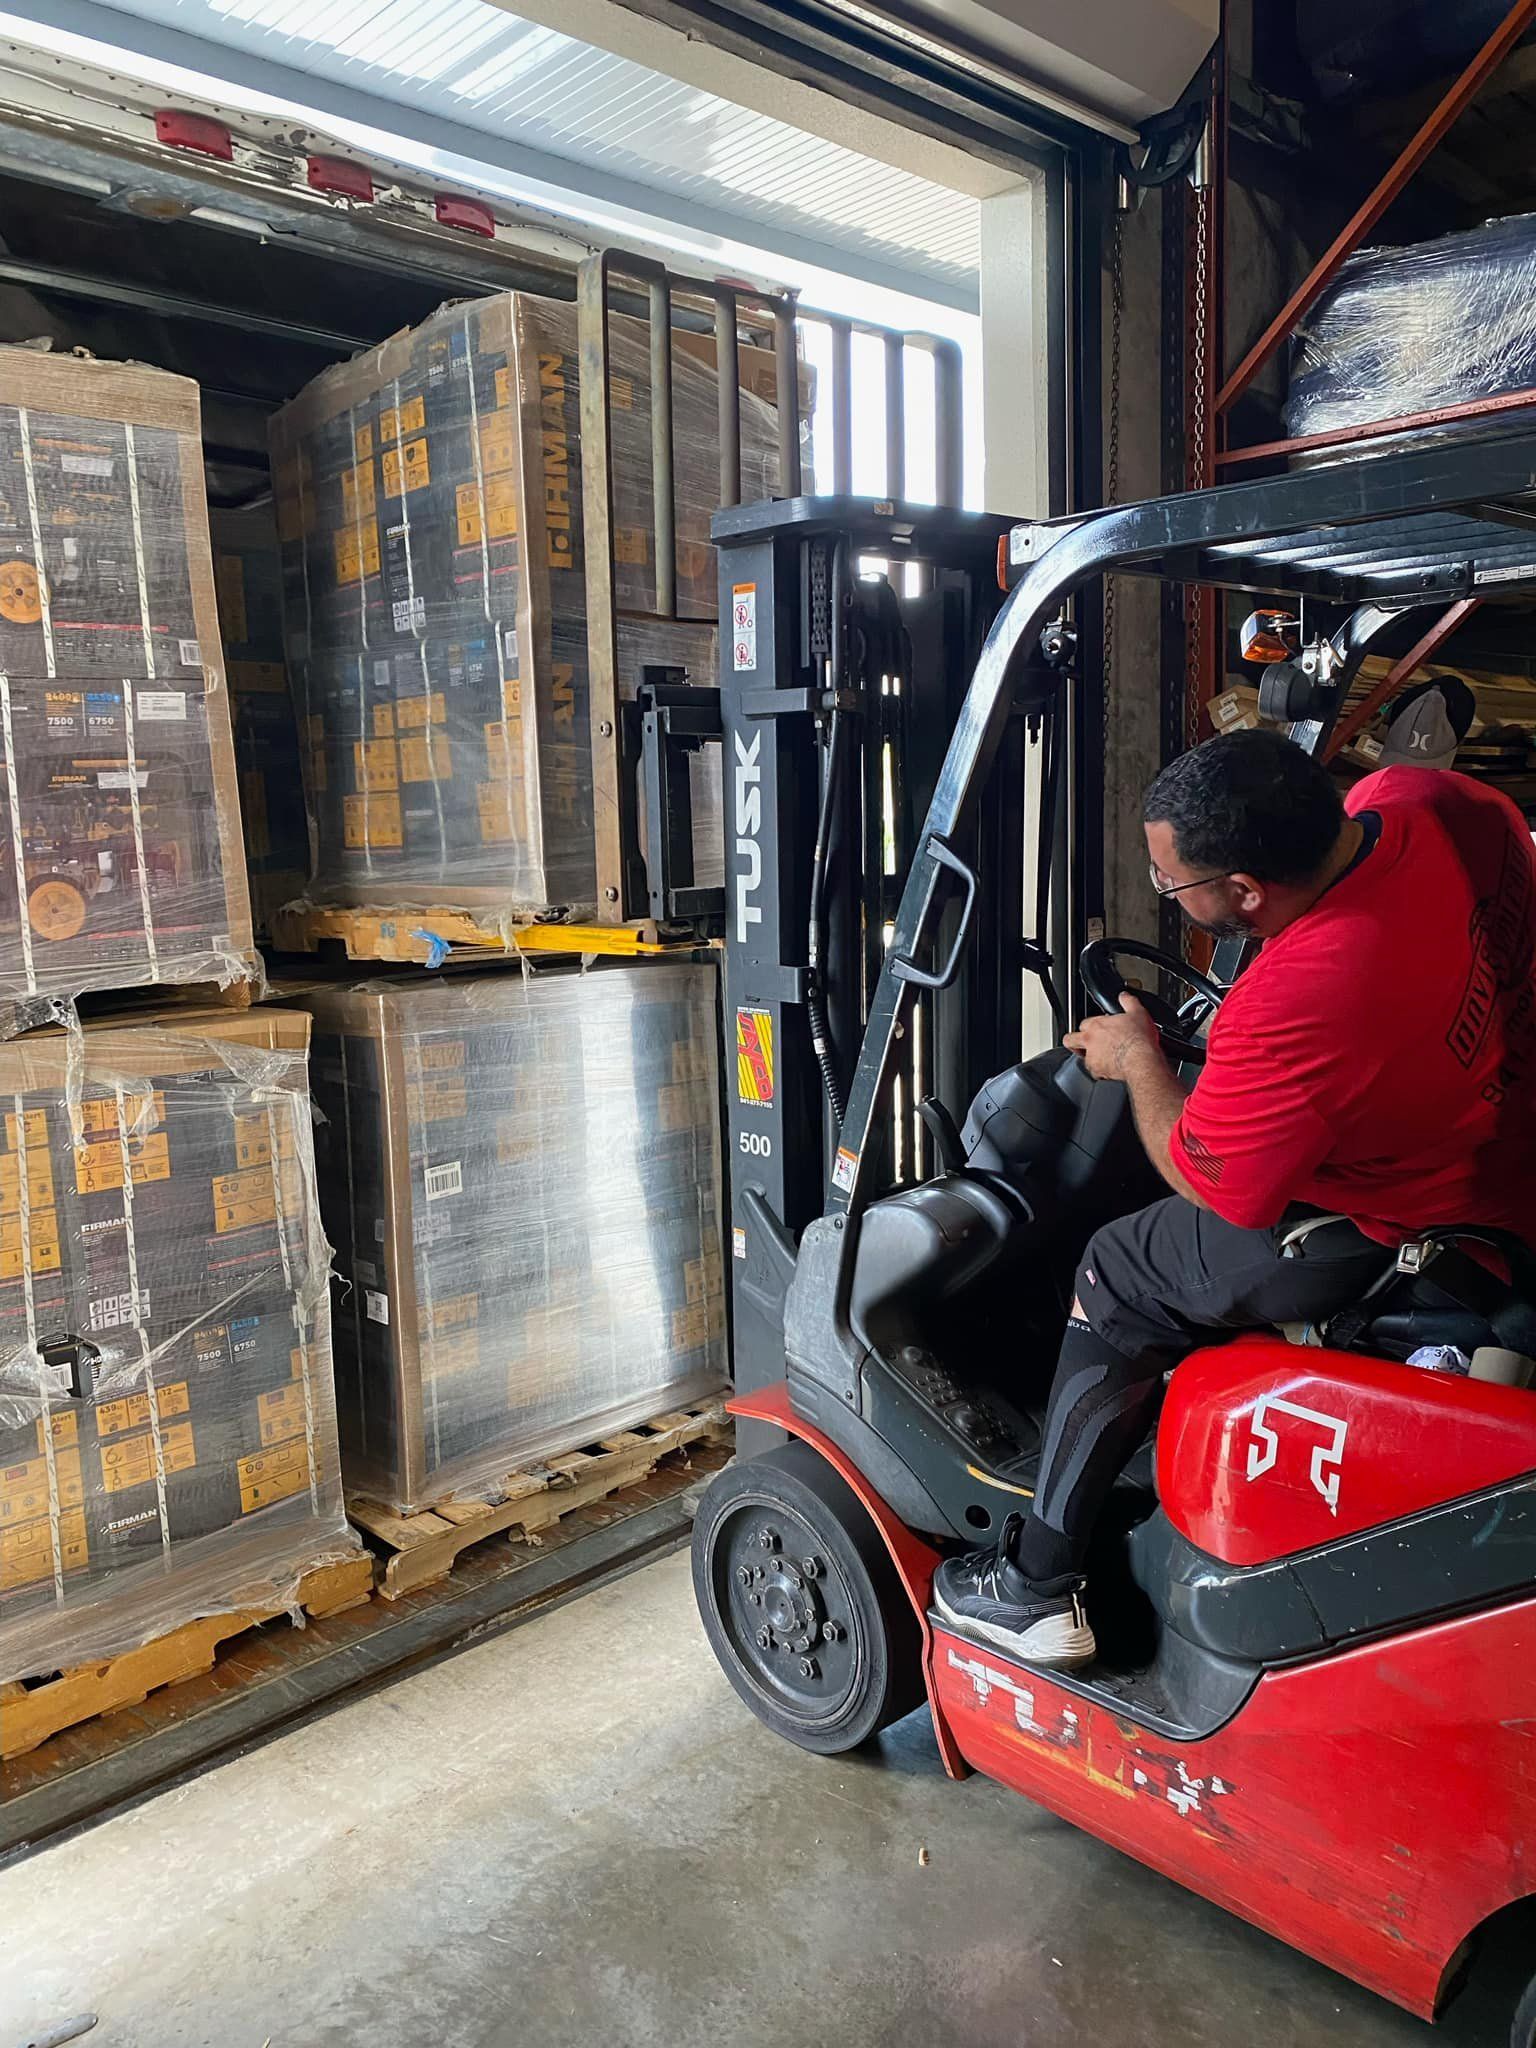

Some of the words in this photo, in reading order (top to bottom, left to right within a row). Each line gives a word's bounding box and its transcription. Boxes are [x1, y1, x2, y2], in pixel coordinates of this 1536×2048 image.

[538, 353, 572, 568] FIRMAN
[47, 717, 74, 725] 7500
[88, 717, 114, 725] 6750
[734, 729, 762, 943] TUSK
[739, 1131, 771, 1158] 500
[234, 1340, 256, 1352] 6750
[197, 1350, 221, 1362] 7500
[109, 1508, 157, 1530] FIRMAN
